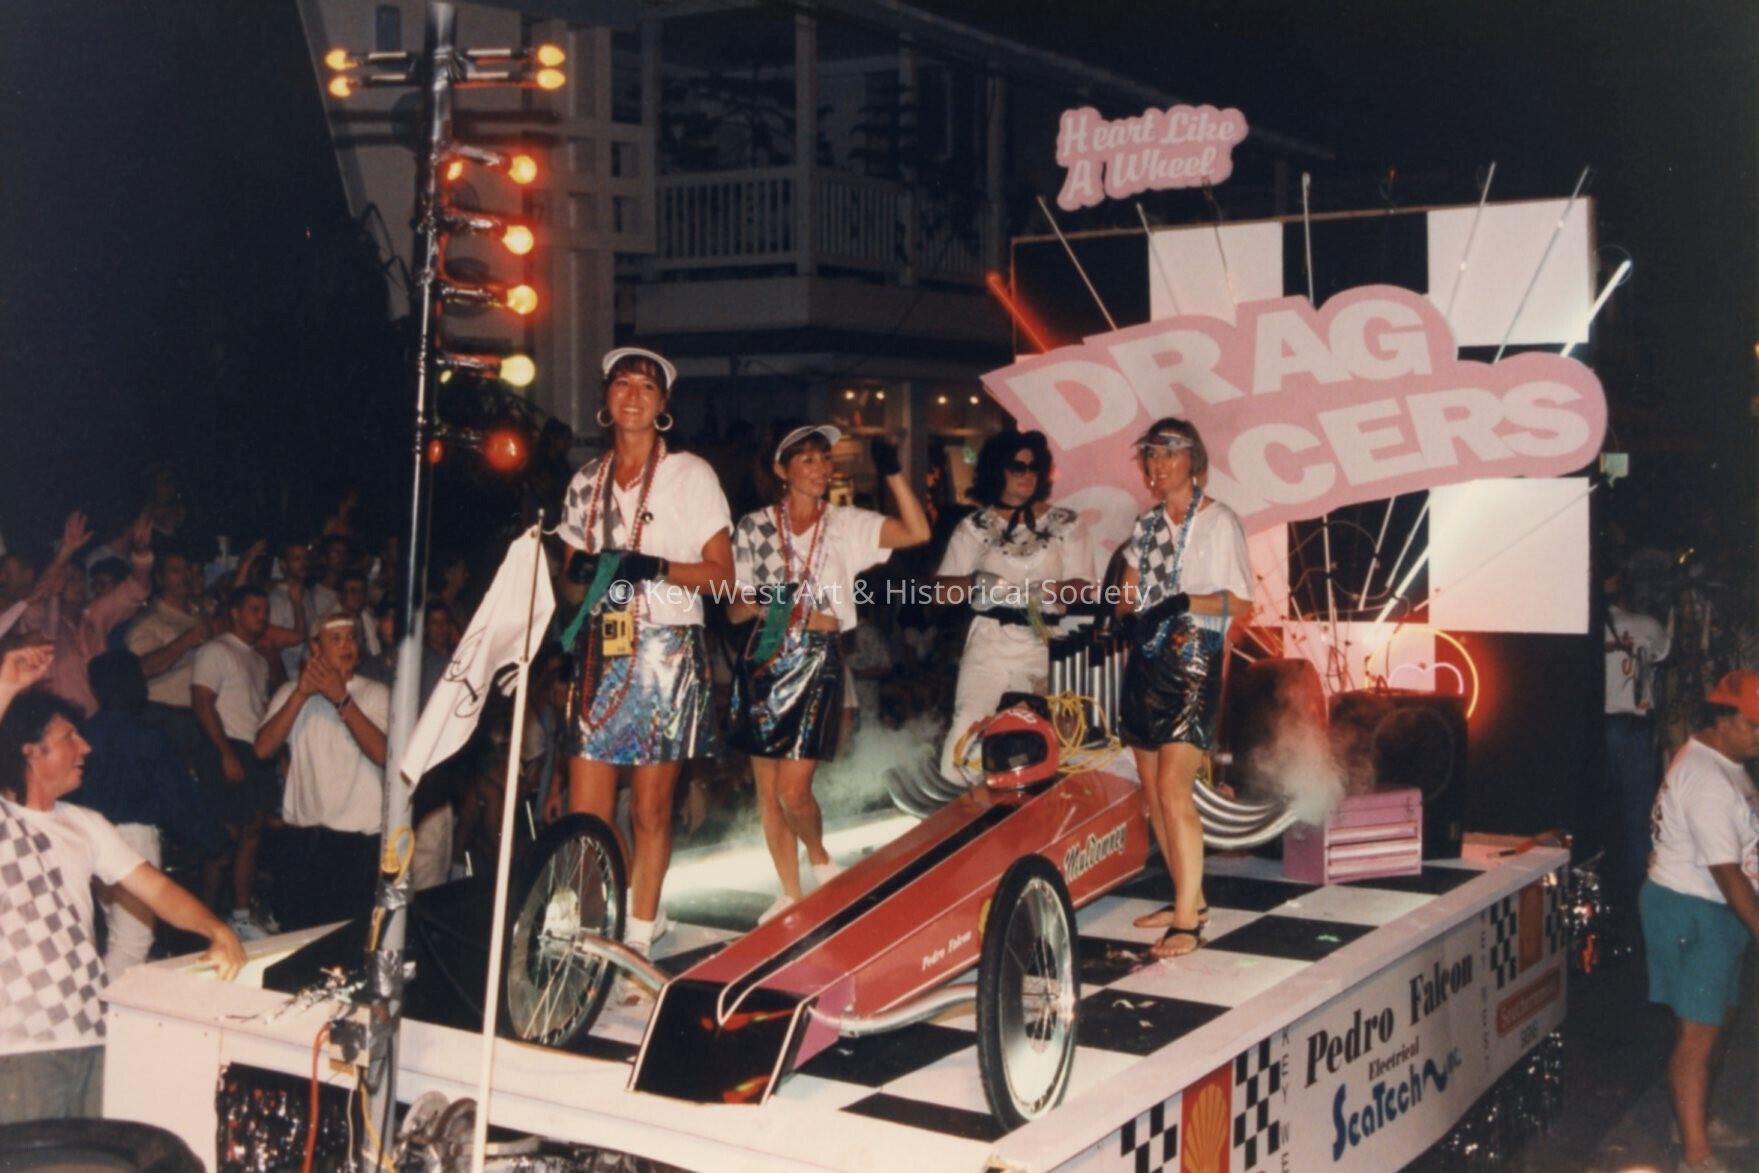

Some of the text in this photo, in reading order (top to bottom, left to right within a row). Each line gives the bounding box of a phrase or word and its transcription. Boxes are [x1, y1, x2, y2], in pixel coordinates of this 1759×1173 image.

[1063, 112, 1236, 158] Heart Like
[1067, 147, 1217, 201] A Wheel
[1006, 300, 1432, 452] DRAG
[1304, 1008, 1395, 1089] Pedro
[1409, 954, 1473, 1026] Falcon
[1280, 1029, 1291, 1105] KEY
[1368, 1036, 1420, 1082] Electrical
